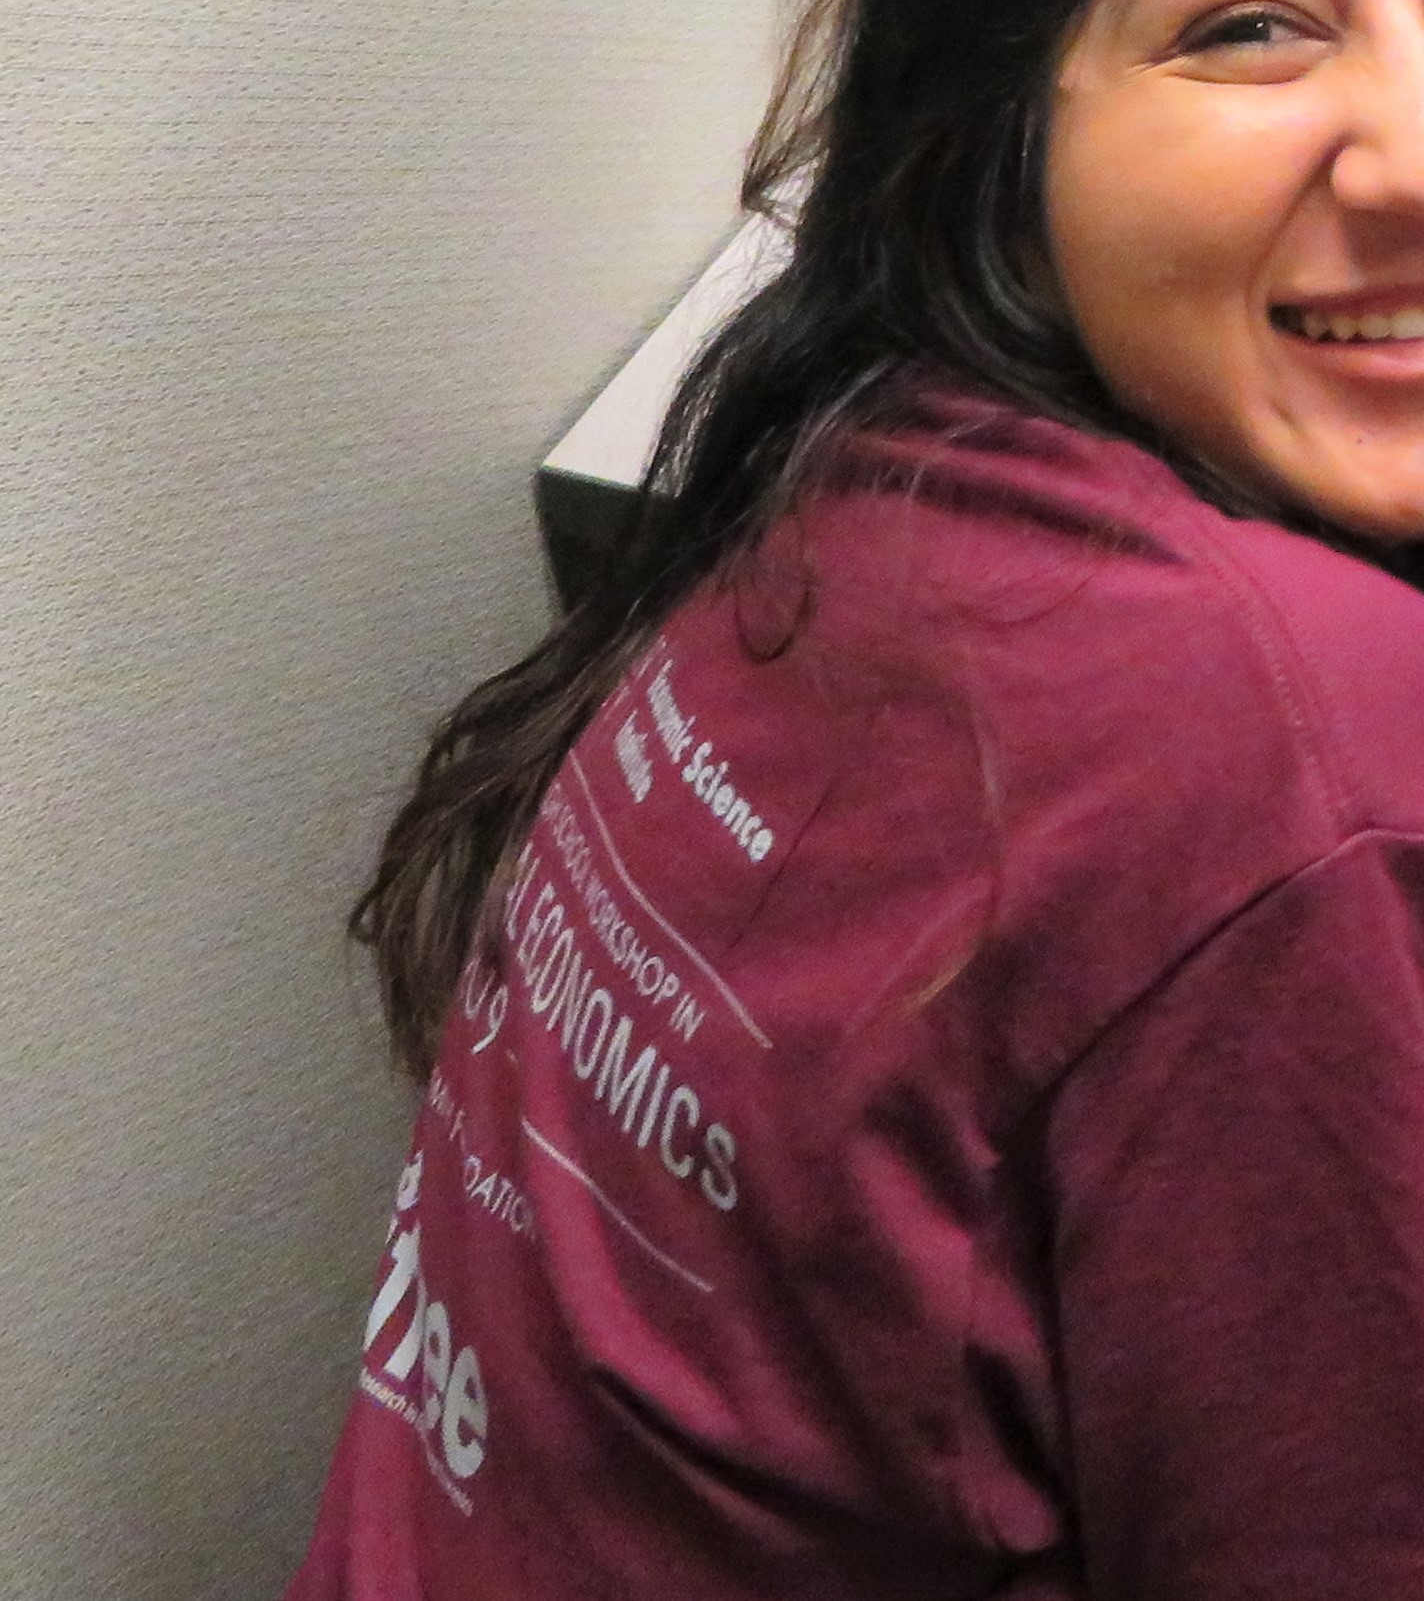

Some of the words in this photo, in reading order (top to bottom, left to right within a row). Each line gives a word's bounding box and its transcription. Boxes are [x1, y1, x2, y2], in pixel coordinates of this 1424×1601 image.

[680, 740, 775, 863] Science
[517, 880, 738, 1213] ECONOMICS
[669, 992, 707, 1043] IN
